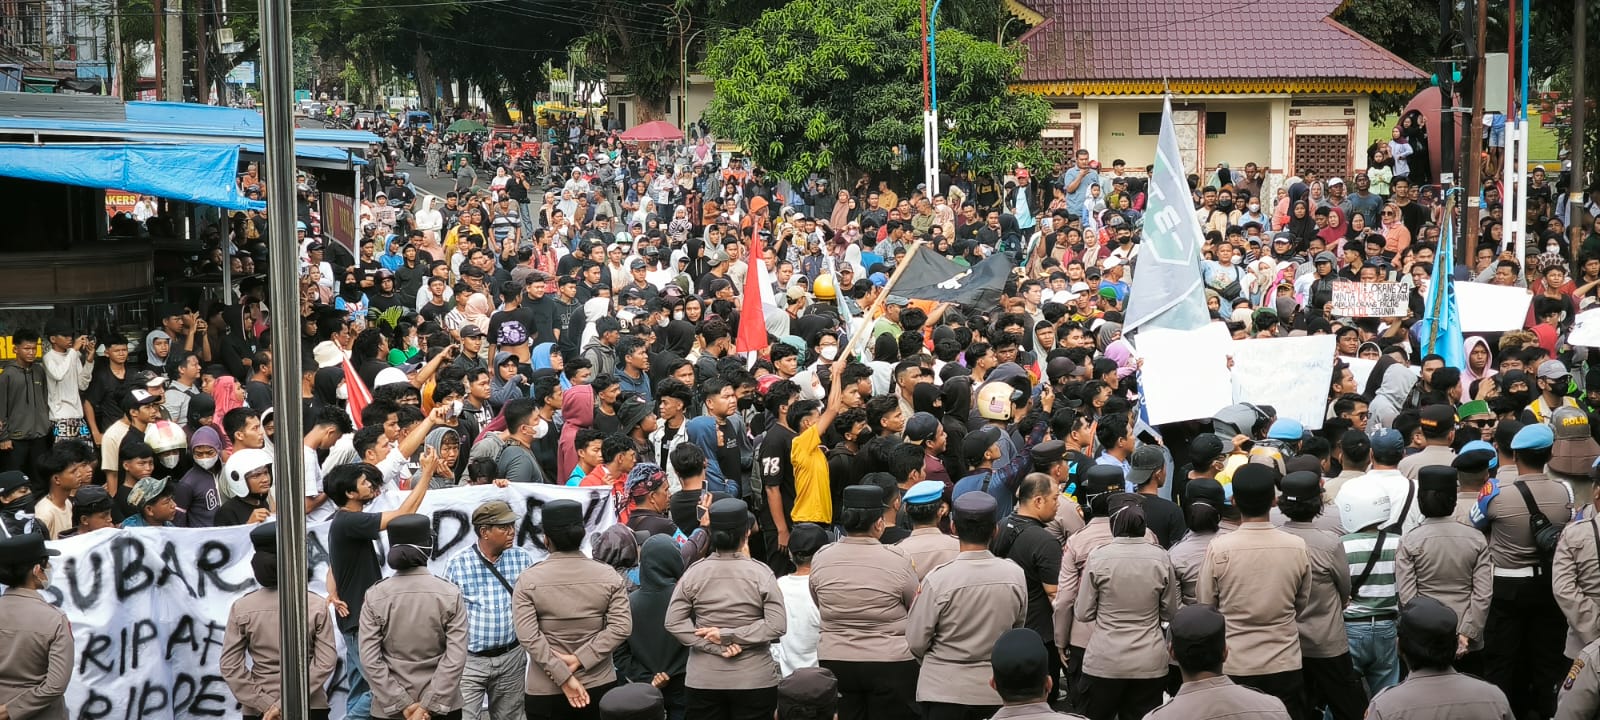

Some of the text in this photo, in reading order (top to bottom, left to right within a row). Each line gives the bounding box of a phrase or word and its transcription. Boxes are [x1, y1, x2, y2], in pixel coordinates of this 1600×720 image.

[762, 456, 780, 476] 78
[79, 618, 159, 676] RIP
[76, 679, 170, 720] RIP
